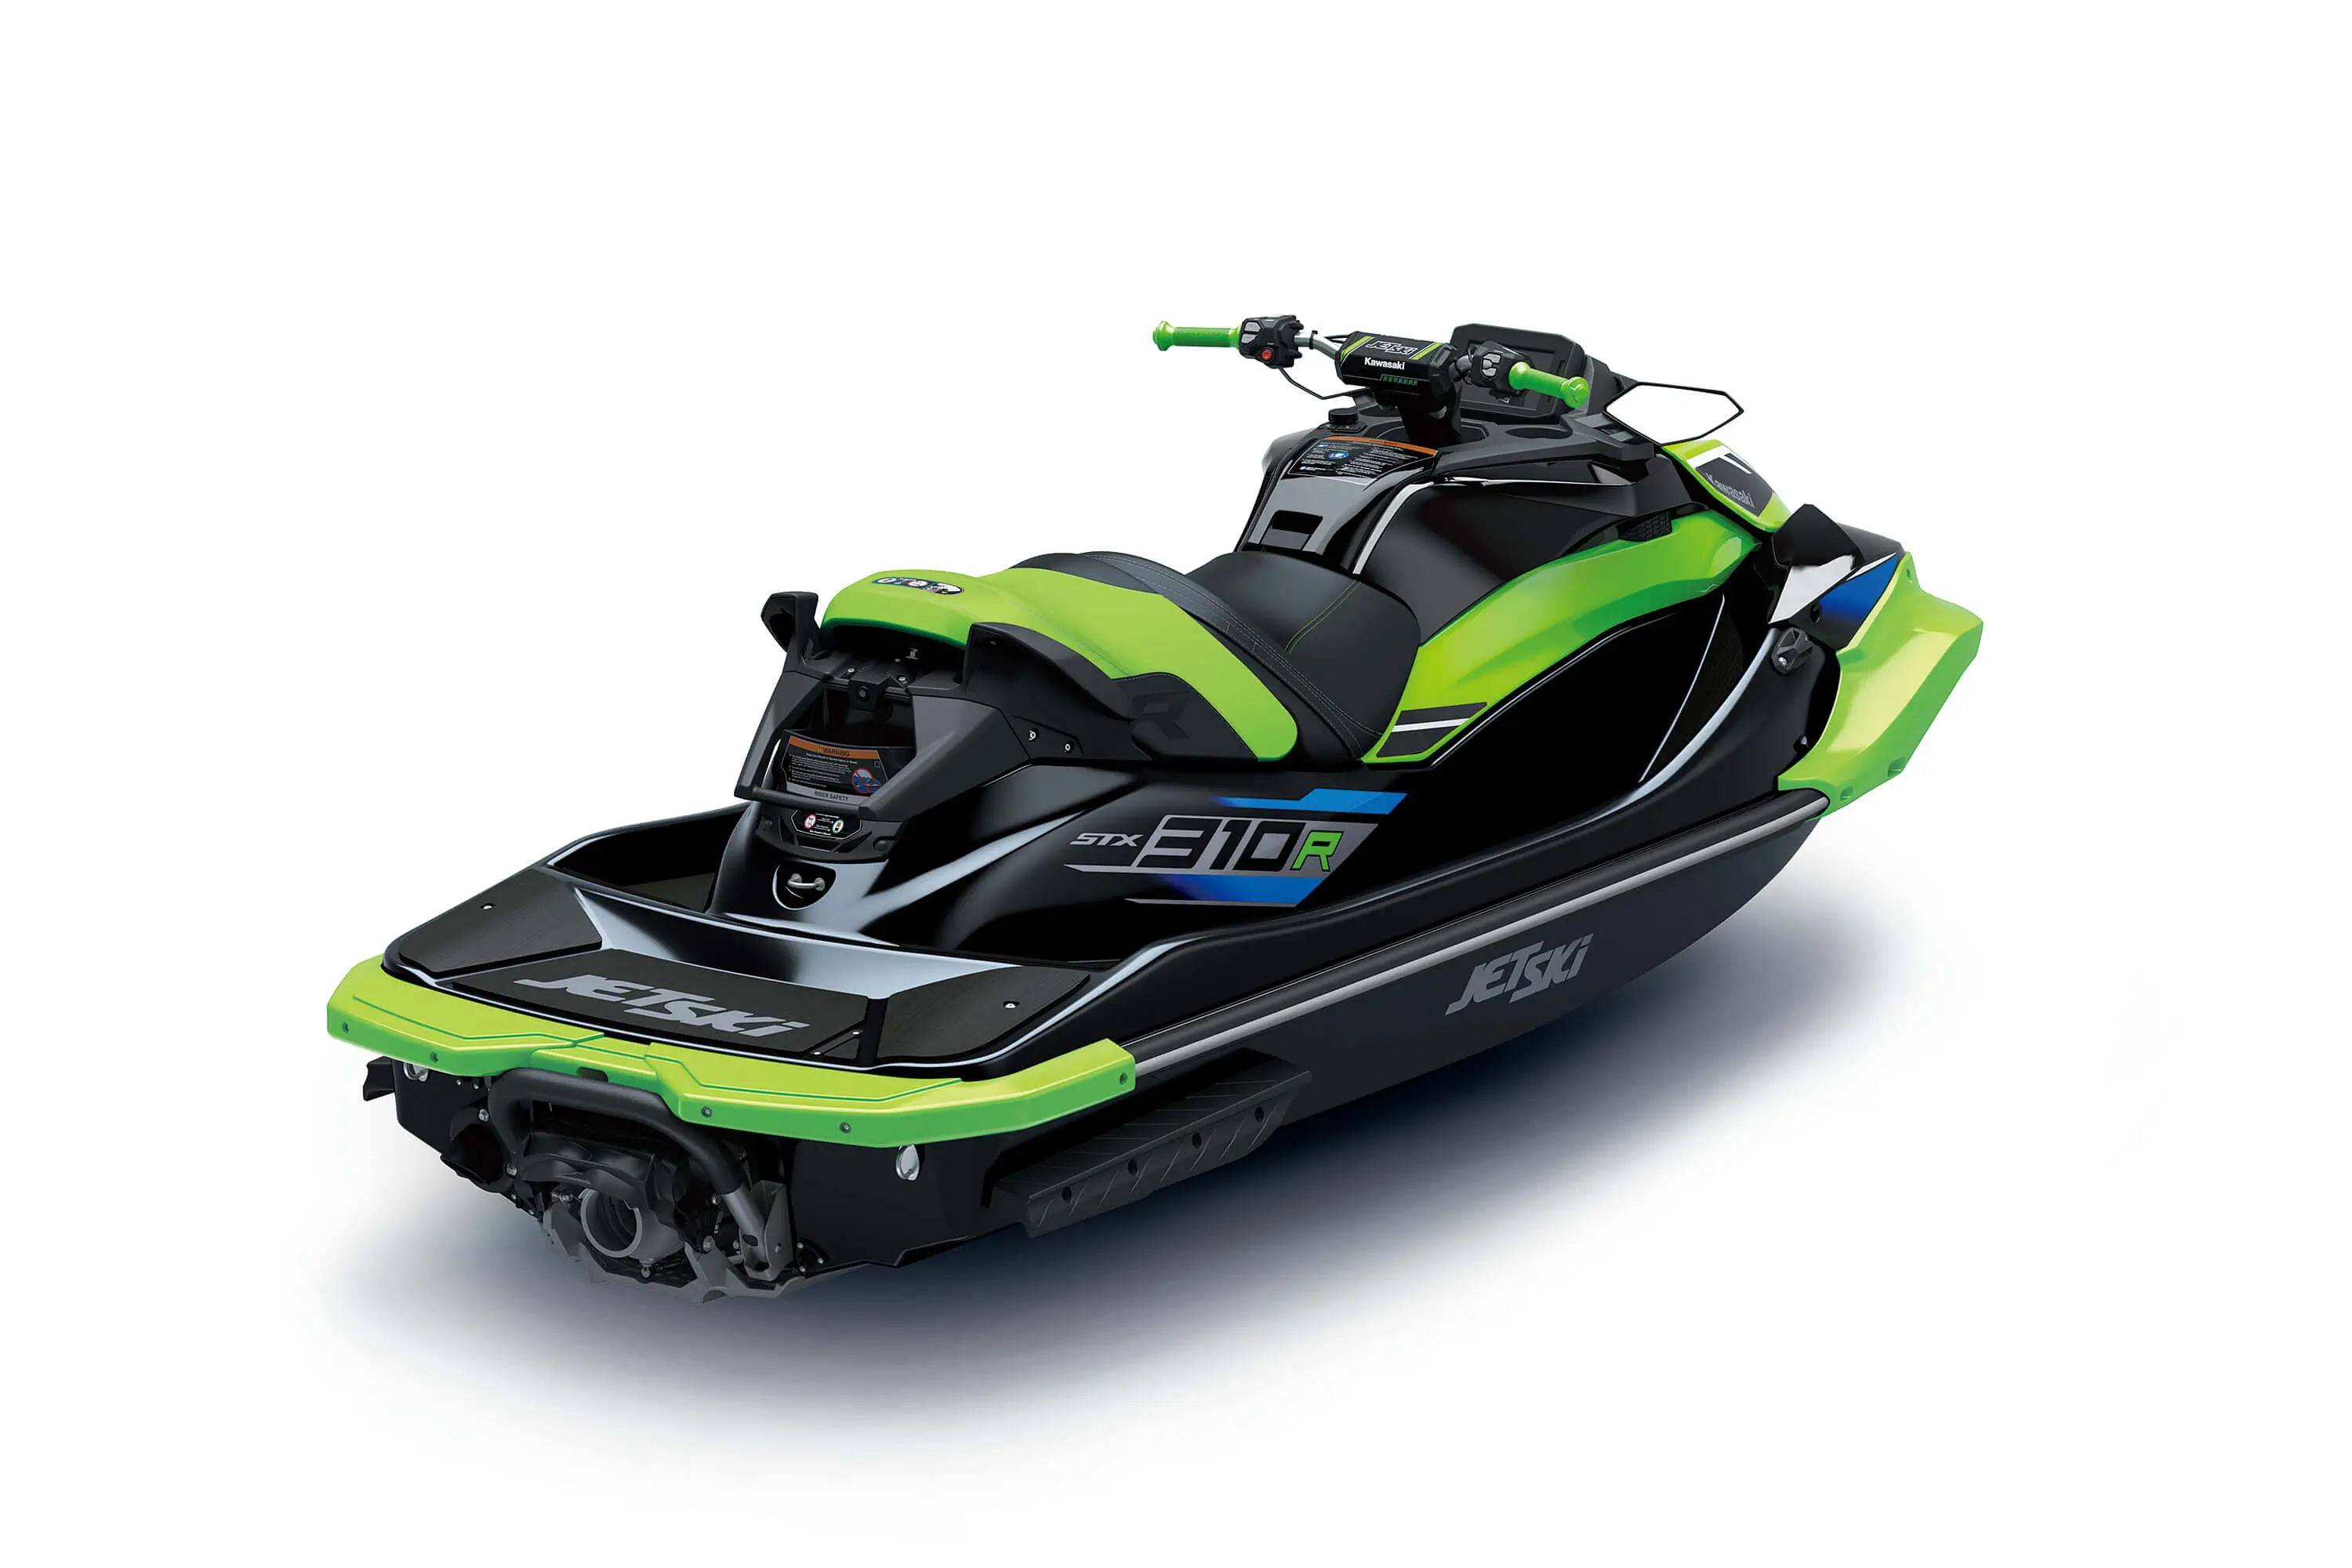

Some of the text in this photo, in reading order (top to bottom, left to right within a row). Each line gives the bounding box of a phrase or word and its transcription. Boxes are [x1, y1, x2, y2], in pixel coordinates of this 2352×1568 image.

[1364, 357, 1406, 370] Kawasaki
[1705, 472, 1755, 508] Kawasaki
[822, 746, 851, 757] WARNING
[814, 790, 830, 799] RIDER
[1069, 833, 1145, 848] STX
